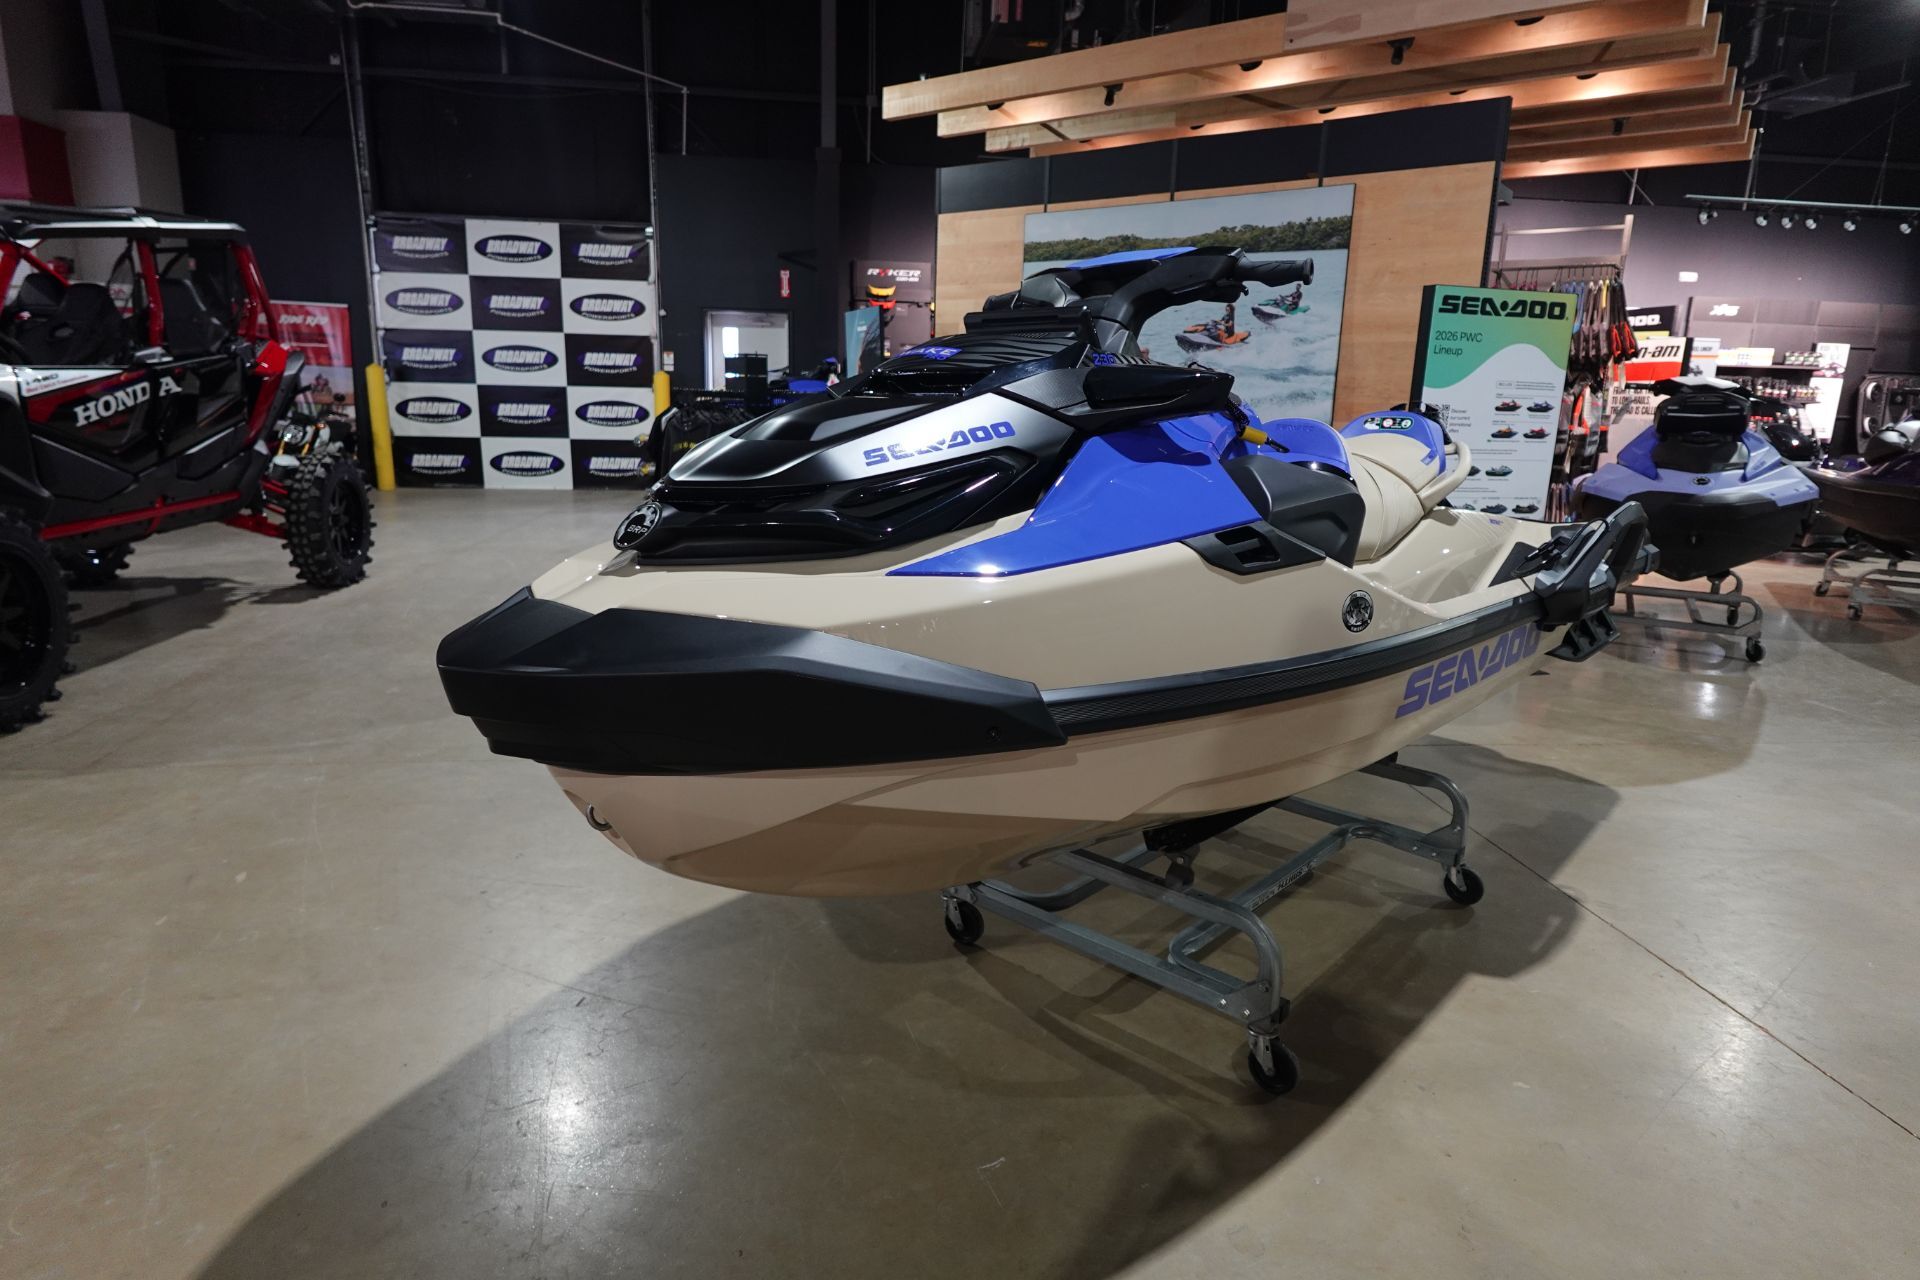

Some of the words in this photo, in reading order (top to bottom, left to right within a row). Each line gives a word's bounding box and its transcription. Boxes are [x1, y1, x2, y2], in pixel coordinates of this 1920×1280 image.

[392, 236, 448, 251] BROADWAY
[486, 239, 541, 254] BROADWAY
[578, 243, 633, 258] BROADWAY
[867, 268, 921, 277] RYKER
[397, 292, 452, 306] BROADWAY
[489, 295, 544, 309] BROADWAY
[581, 297, 635, 312] BROADWAY
[1435, 330, 1458, 341] 2026
[1459, 332, 1483, 343] PWC
[401, 347, 456, 361] BROADWAY
[493, 349, 547, 364] BROADWAY
[1433, 345, 1463, 356] Lineup
[1639, 345, 1680, 358] n-am
[583, 352, 637, 366] BROADWAY
[73, 376, 183, 427] HONDA
[407, 401, 461, 415] BROADWAY
[497, 403, 551, 417] BROADWAY
[586, 405, 639, 419] BROADWAY
[411, 454, 465, 467] BROADWAY
[501, 456, 554, 469] BROADWAY
[589, 457, 641, 470] BROADWAY
[589, 469, 639, 477] POWERSPORT
